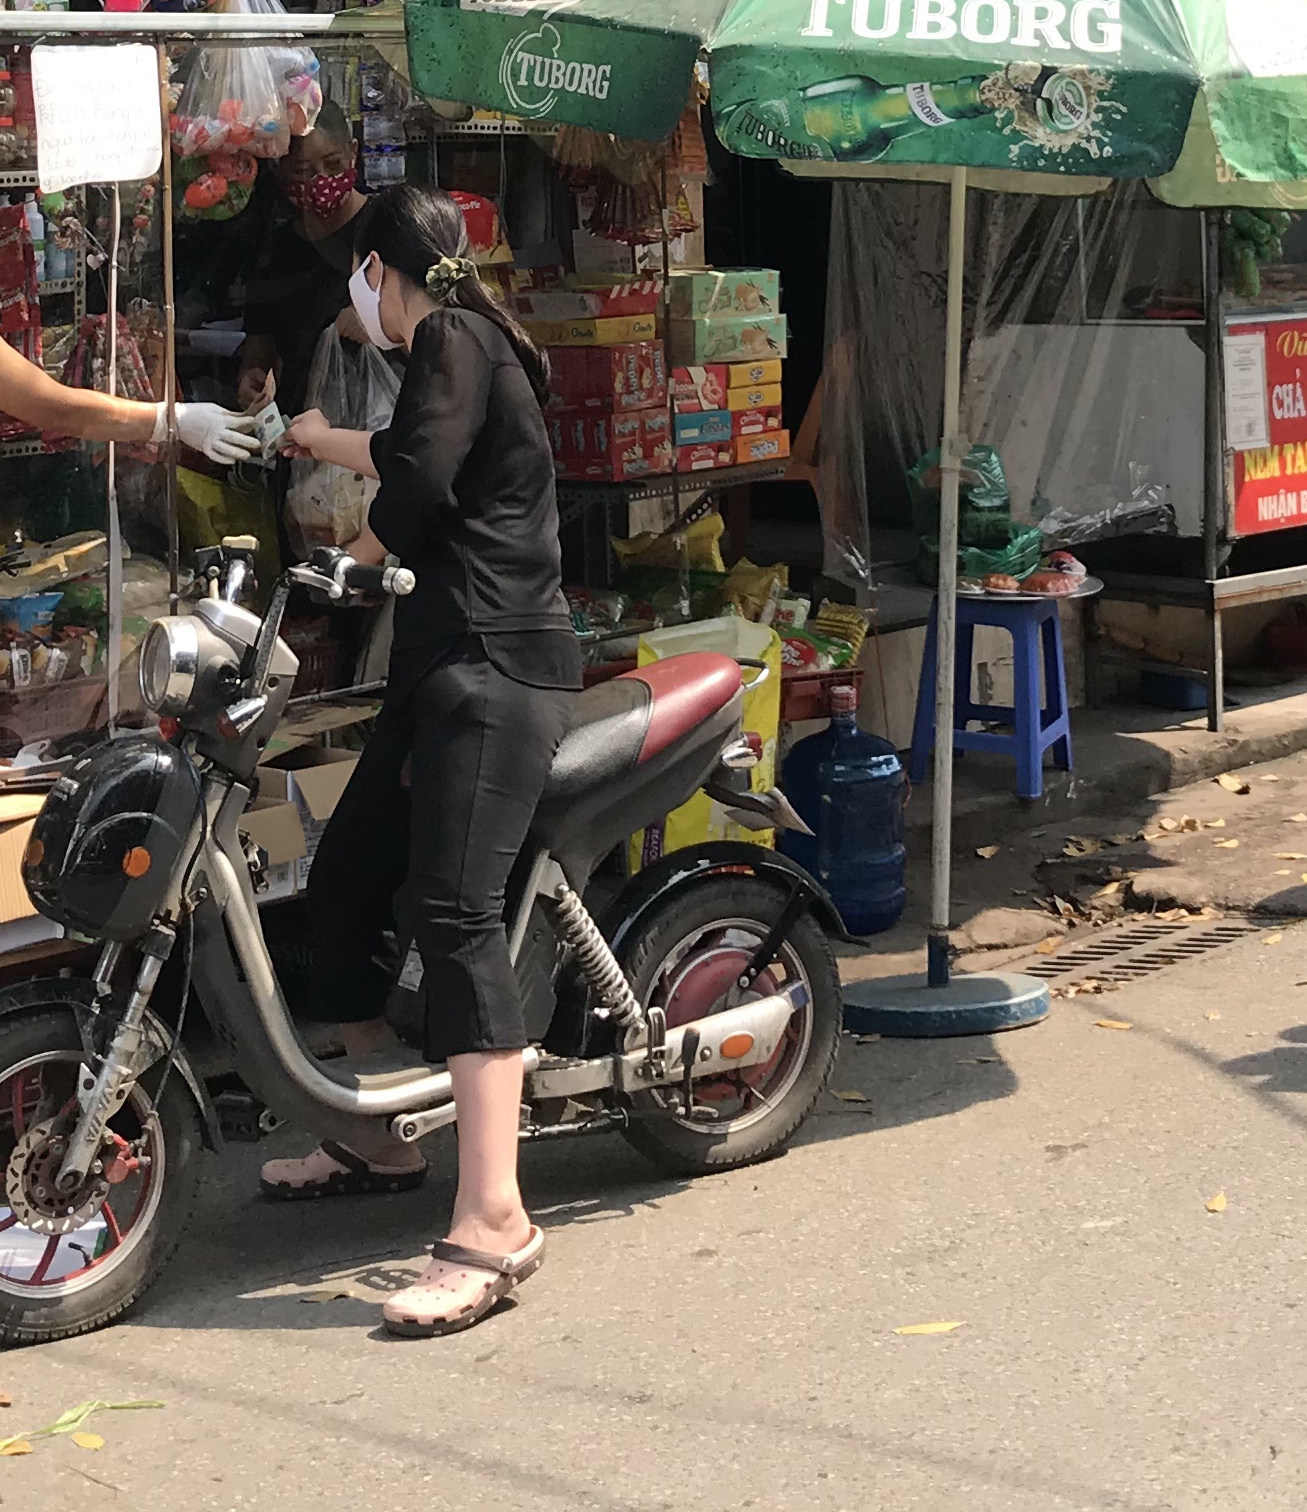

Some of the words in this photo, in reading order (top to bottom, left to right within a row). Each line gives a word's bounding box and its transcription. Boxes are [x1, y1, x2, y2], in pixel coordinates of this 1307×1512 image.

[516, 51, 612, 101] TUBORG
[1272, 368, 1307, 420] CHẢ
[1244, 445, 1282, 482] NEM
[1257, 491, 1297, 523] NHẬN
